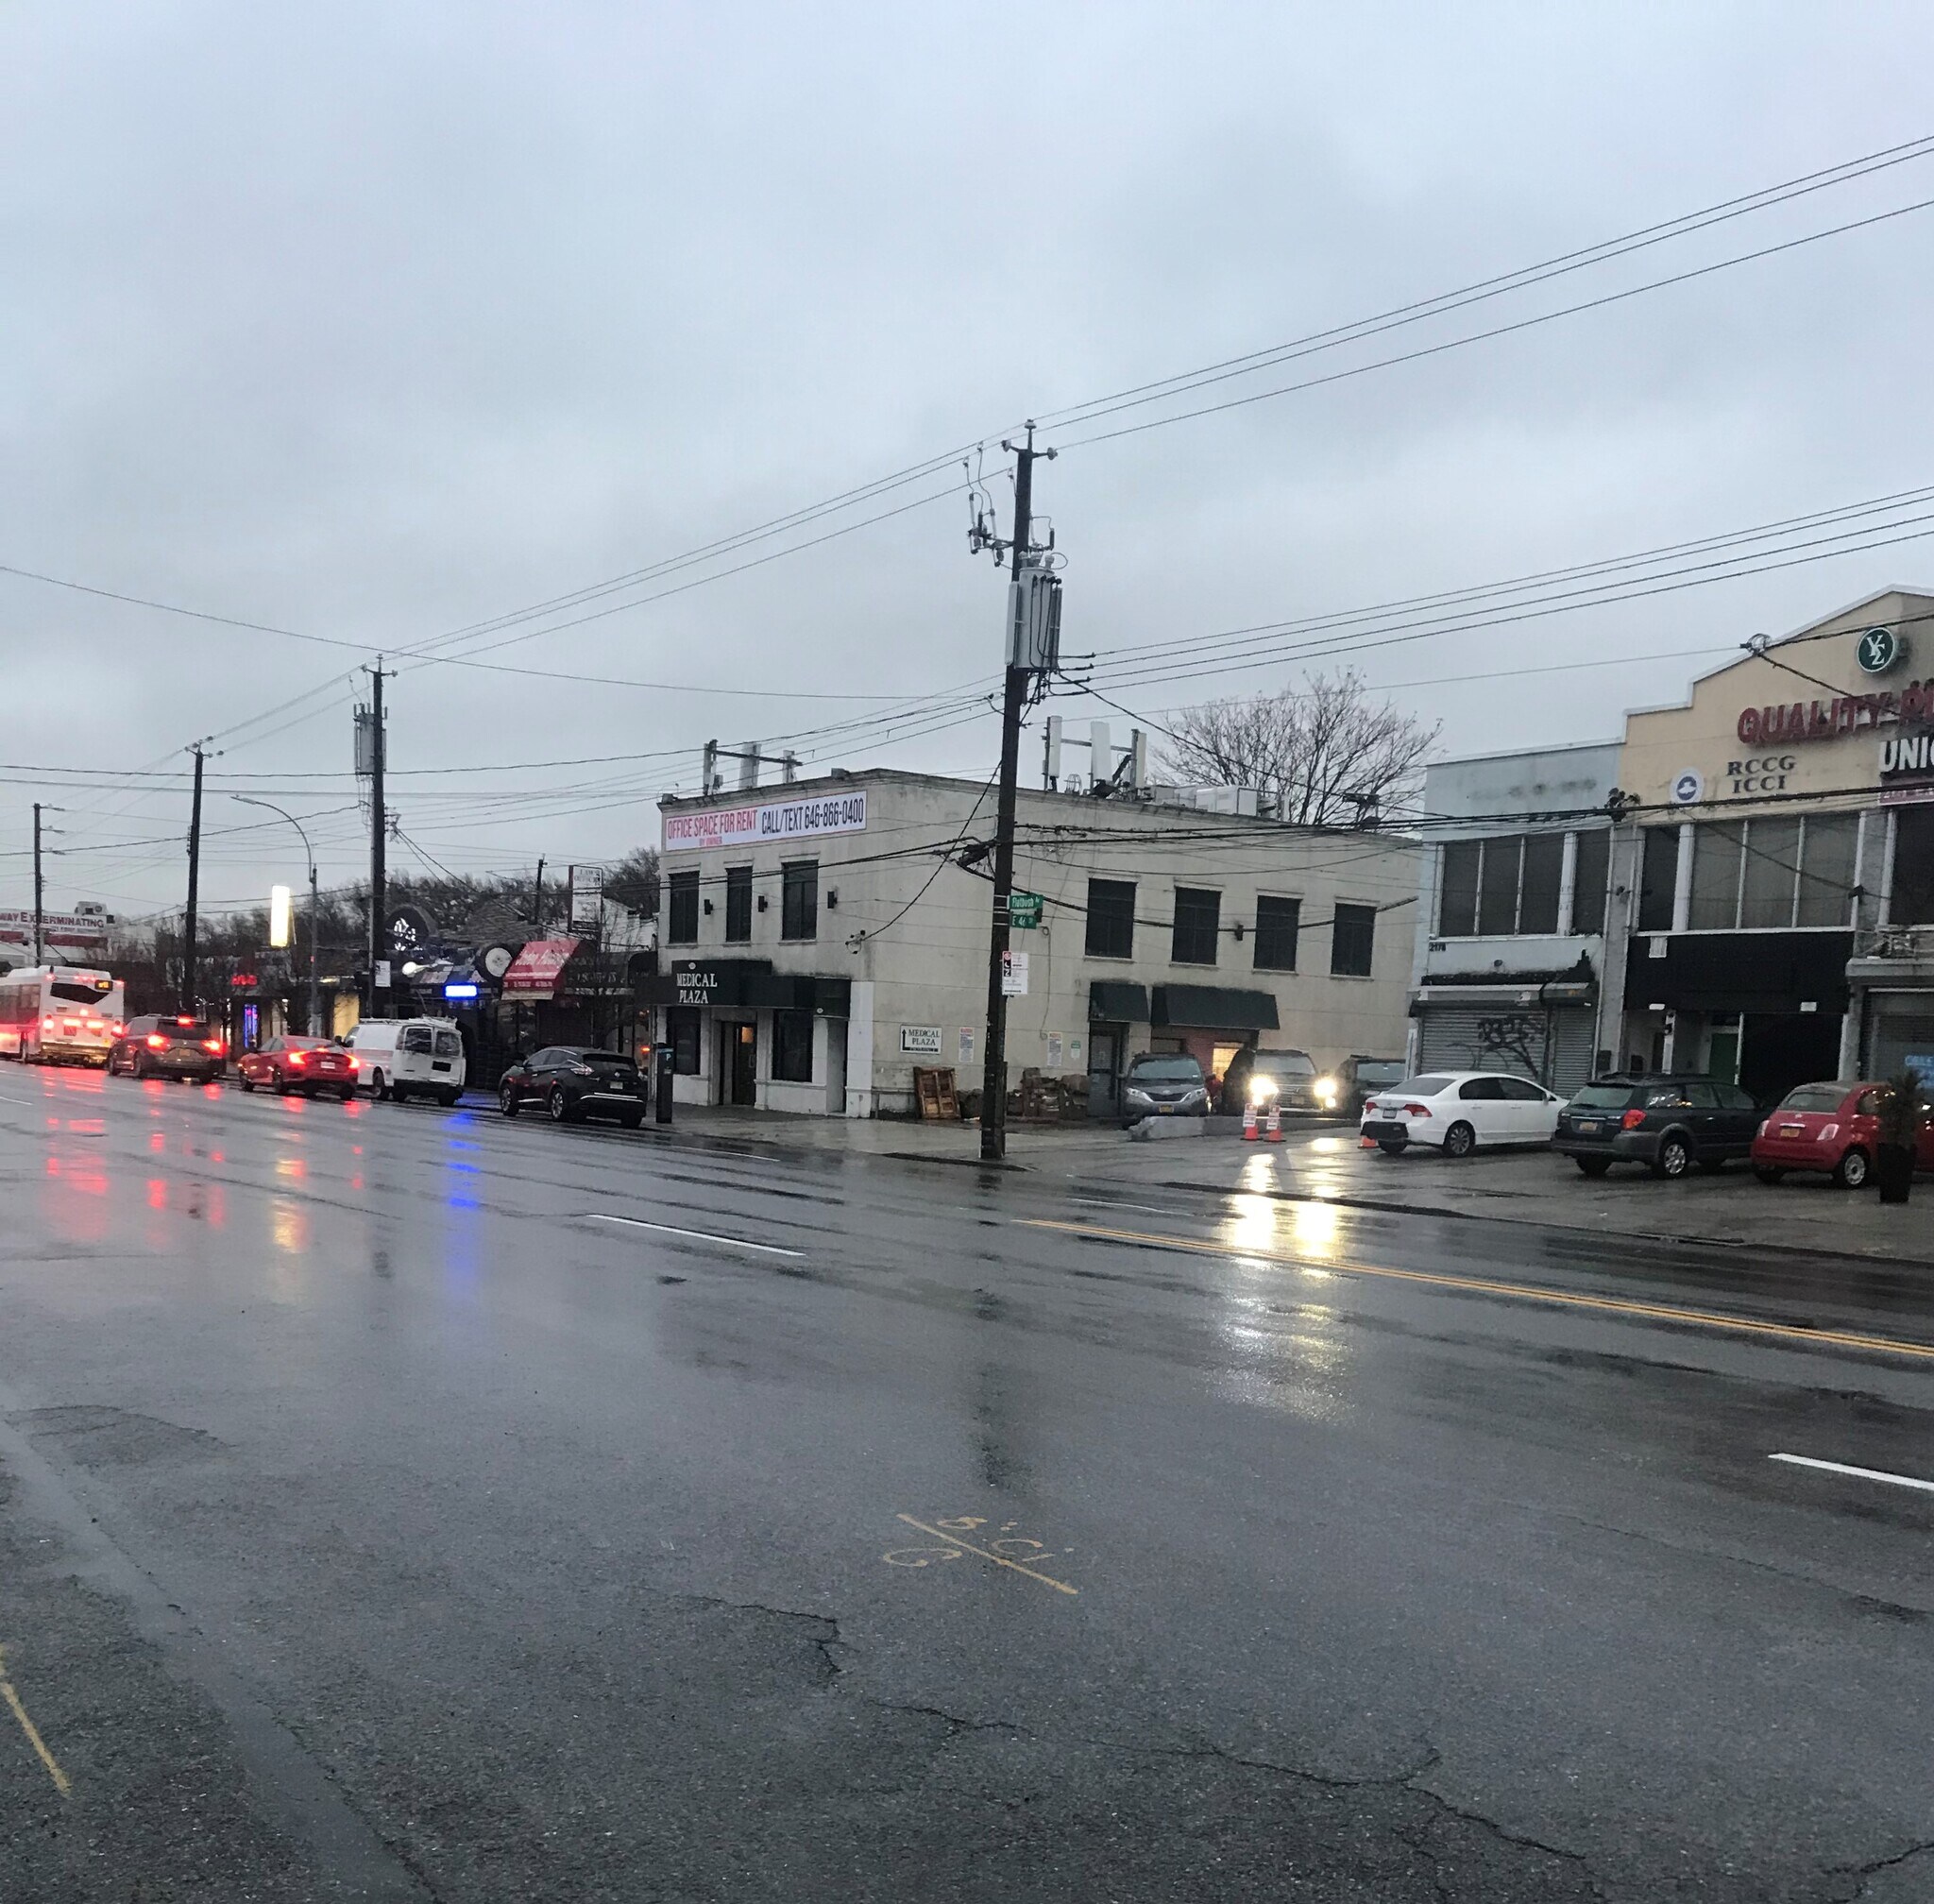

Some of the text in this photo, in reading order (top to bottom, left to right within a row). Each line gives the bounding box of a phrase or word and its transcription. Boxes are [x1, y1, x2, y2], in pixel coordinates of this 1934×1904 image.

[1737, 691, 1892, 744] QUALITY
[1727, 756, 1796, 775] RCCG
[1733, 775, 1785, 793] ICCI
[668, 797, 864, 840] OFFICE SPACE FOR RENT CALL/TEXT 646-866-0400
[1011, 896, 1034, 908] Flatbush
[20, 911, 104, 928] EXERMINATING
[1011, 915, 1017, 926] E
[676, 973, 718, 988] MEDICAL
[679, 989, 709, 1004] PLAZA
[908, 1028, 941, 1038] MEDICAL
[911, 1038, 937, 1046] PLAZA
